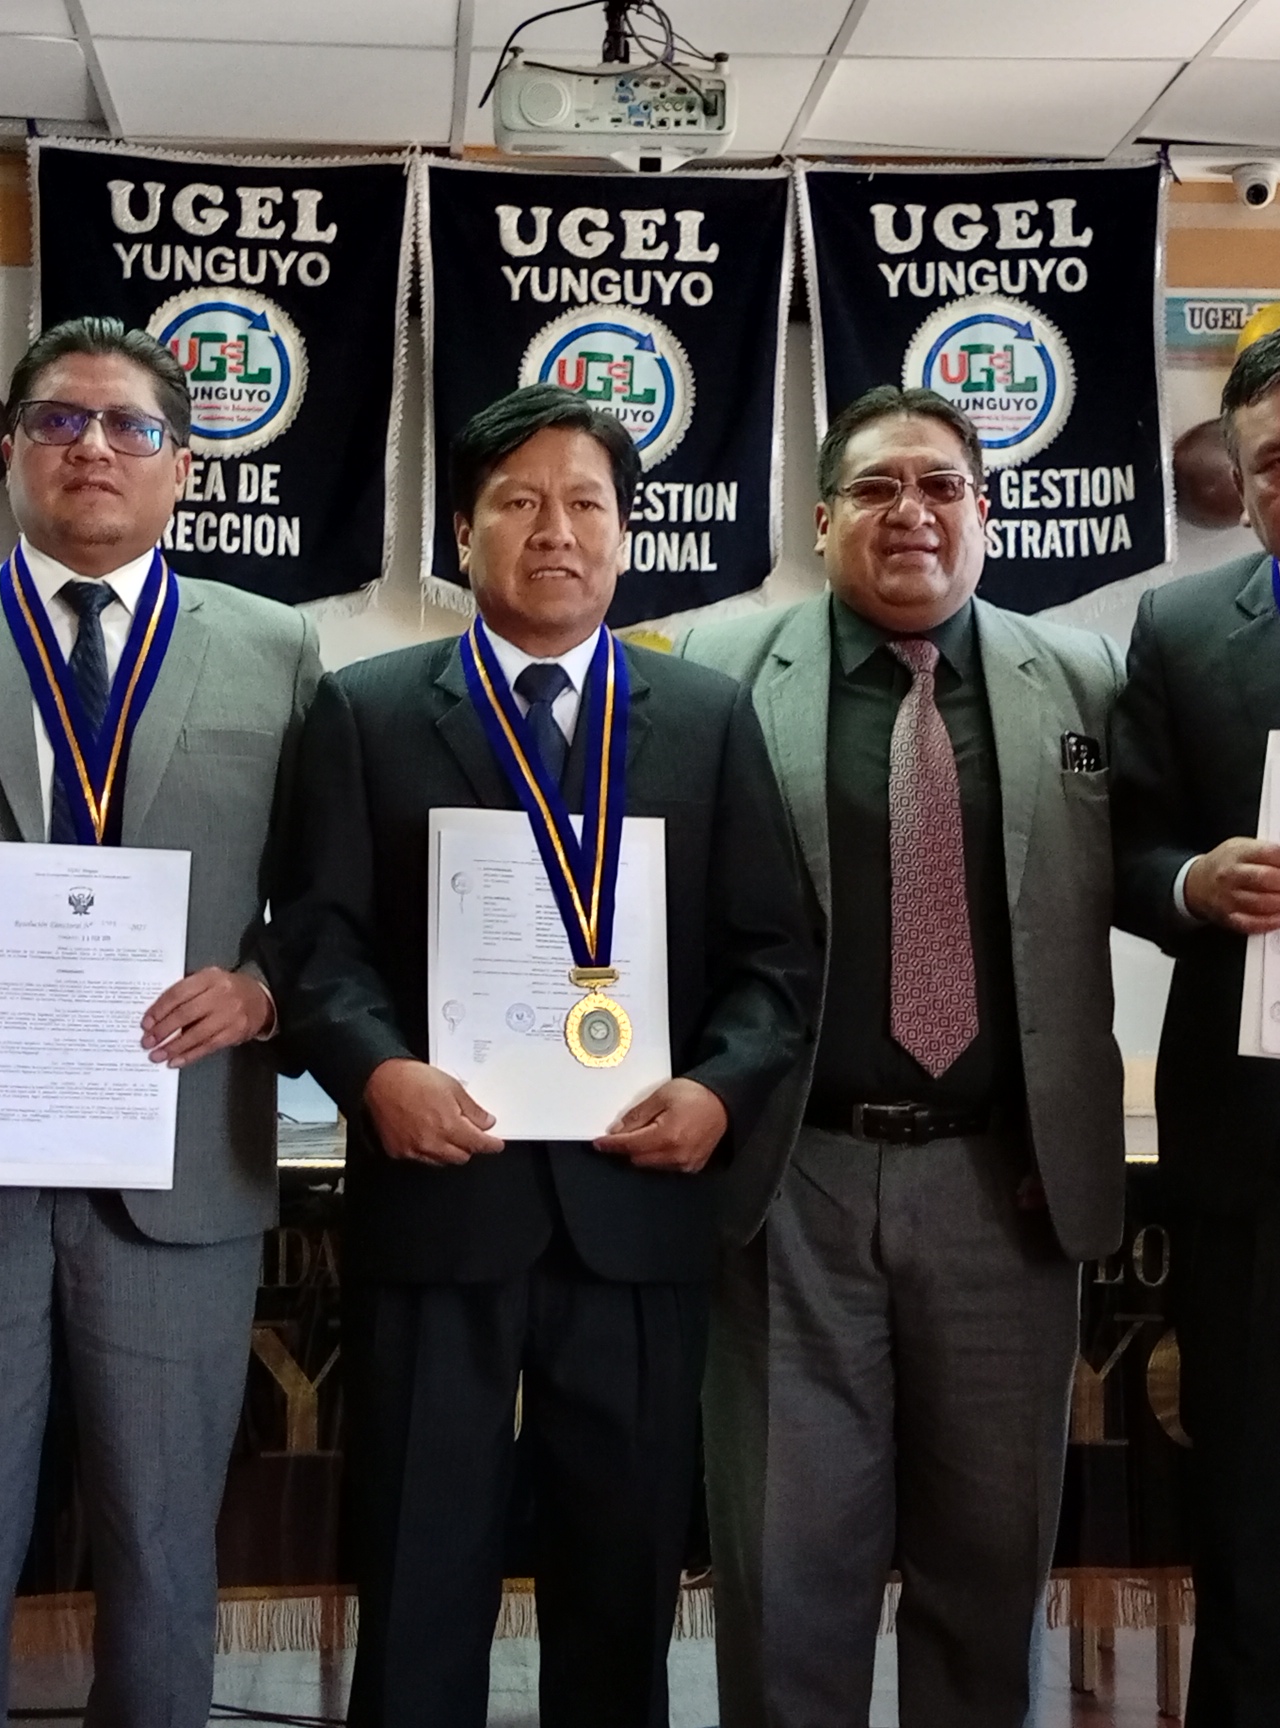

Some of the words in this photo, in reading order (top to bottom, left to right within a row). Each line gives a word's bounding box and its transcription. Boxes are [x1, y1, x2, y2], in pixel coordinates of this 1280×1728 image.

[106, 180, 337, 243] UGEL
[495, 204, 719, 263] UGEL
[869, 199, 1093, 254] UGEL
[113, 243, 331, 287] YUNGUYO
[501, 265, 713, 306] YUNGUYO
[878, 257, 1088, 298] YUNGUYO
[188, 386, 271, 403] UNGUYO
[237, 462, 281, 505] DE
[1000, 464, 1135, 510] GESTION
